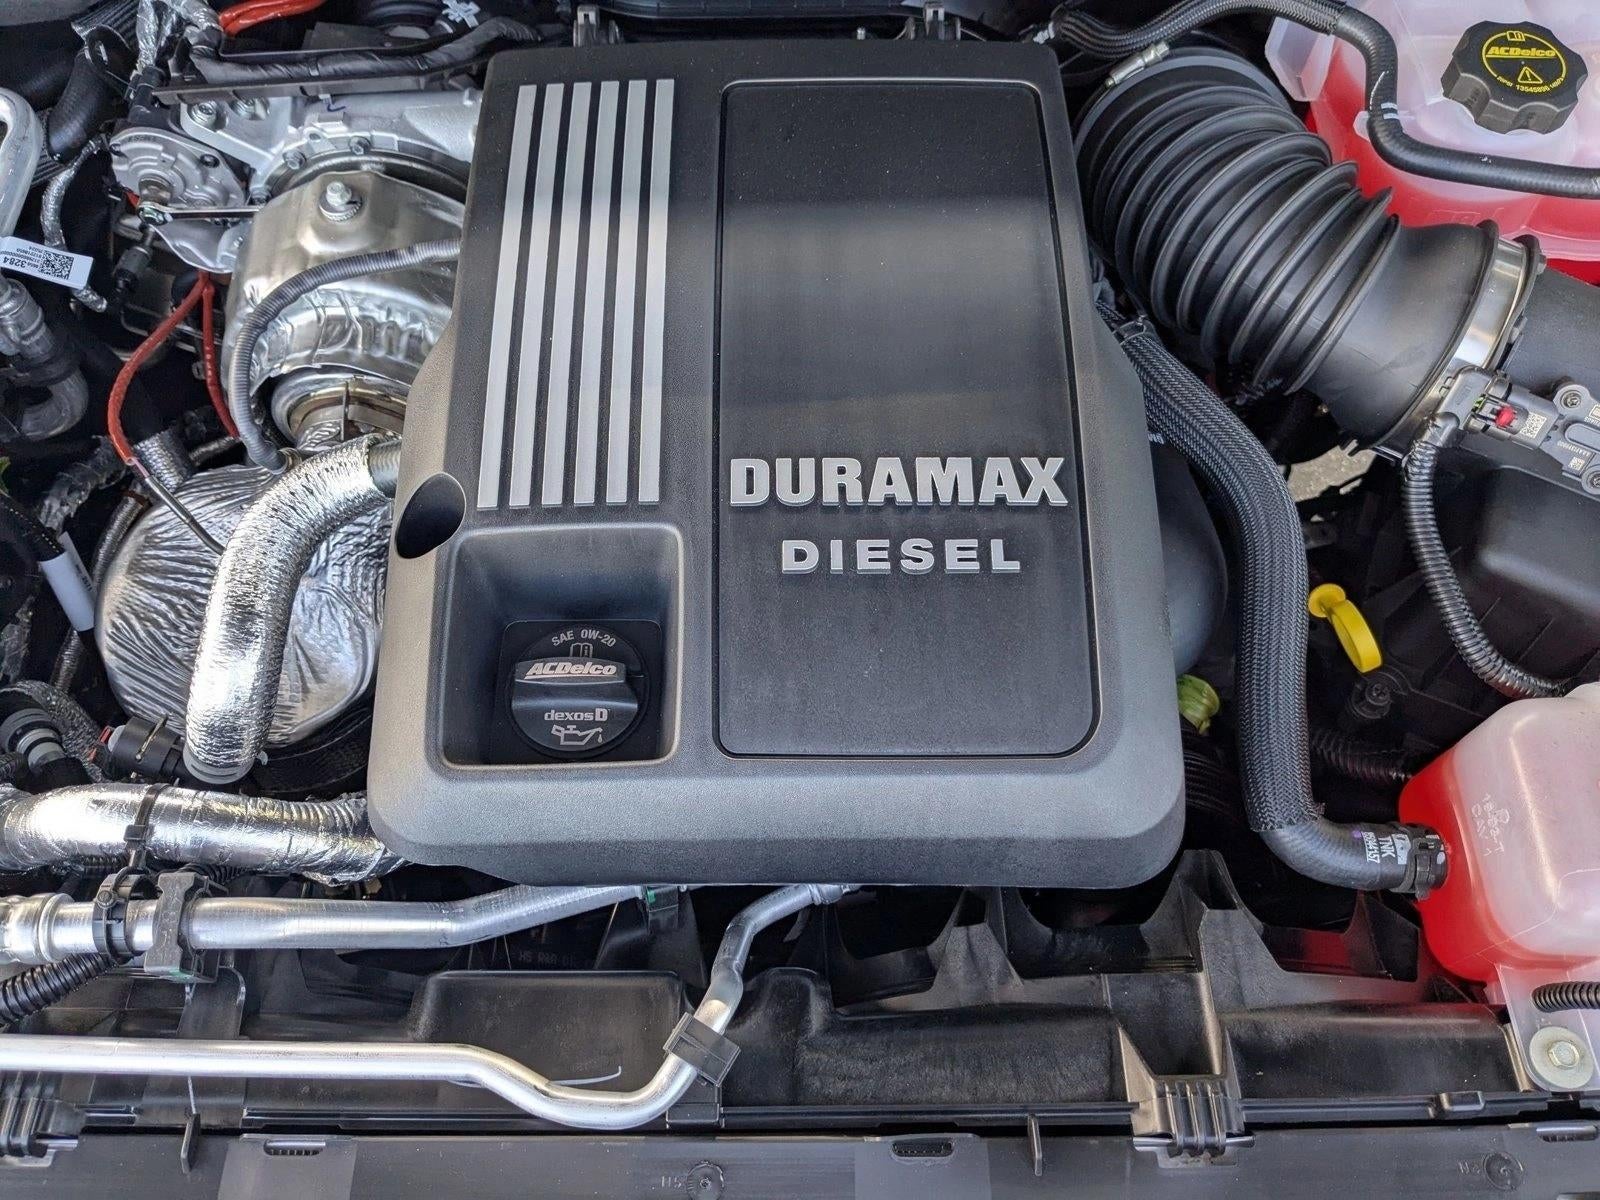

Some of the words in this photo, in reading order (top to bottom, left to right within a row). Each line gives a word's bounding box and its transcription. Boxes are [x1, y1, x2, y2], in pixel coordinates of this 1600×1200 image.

[1487, 46, 1556, 57] ACDelco
[2, 256, 27, 269] 3284
[730, 457, 1069, 506] DURAMAX
[782, 538, 1021, 574] DIESEL
[551, 630, 575, 647] SAE
[580, 629, 616, 648] 0W-20
[525, 662, 617, 677] ACDelco
[1378, 835, 1396, 858] TNK
